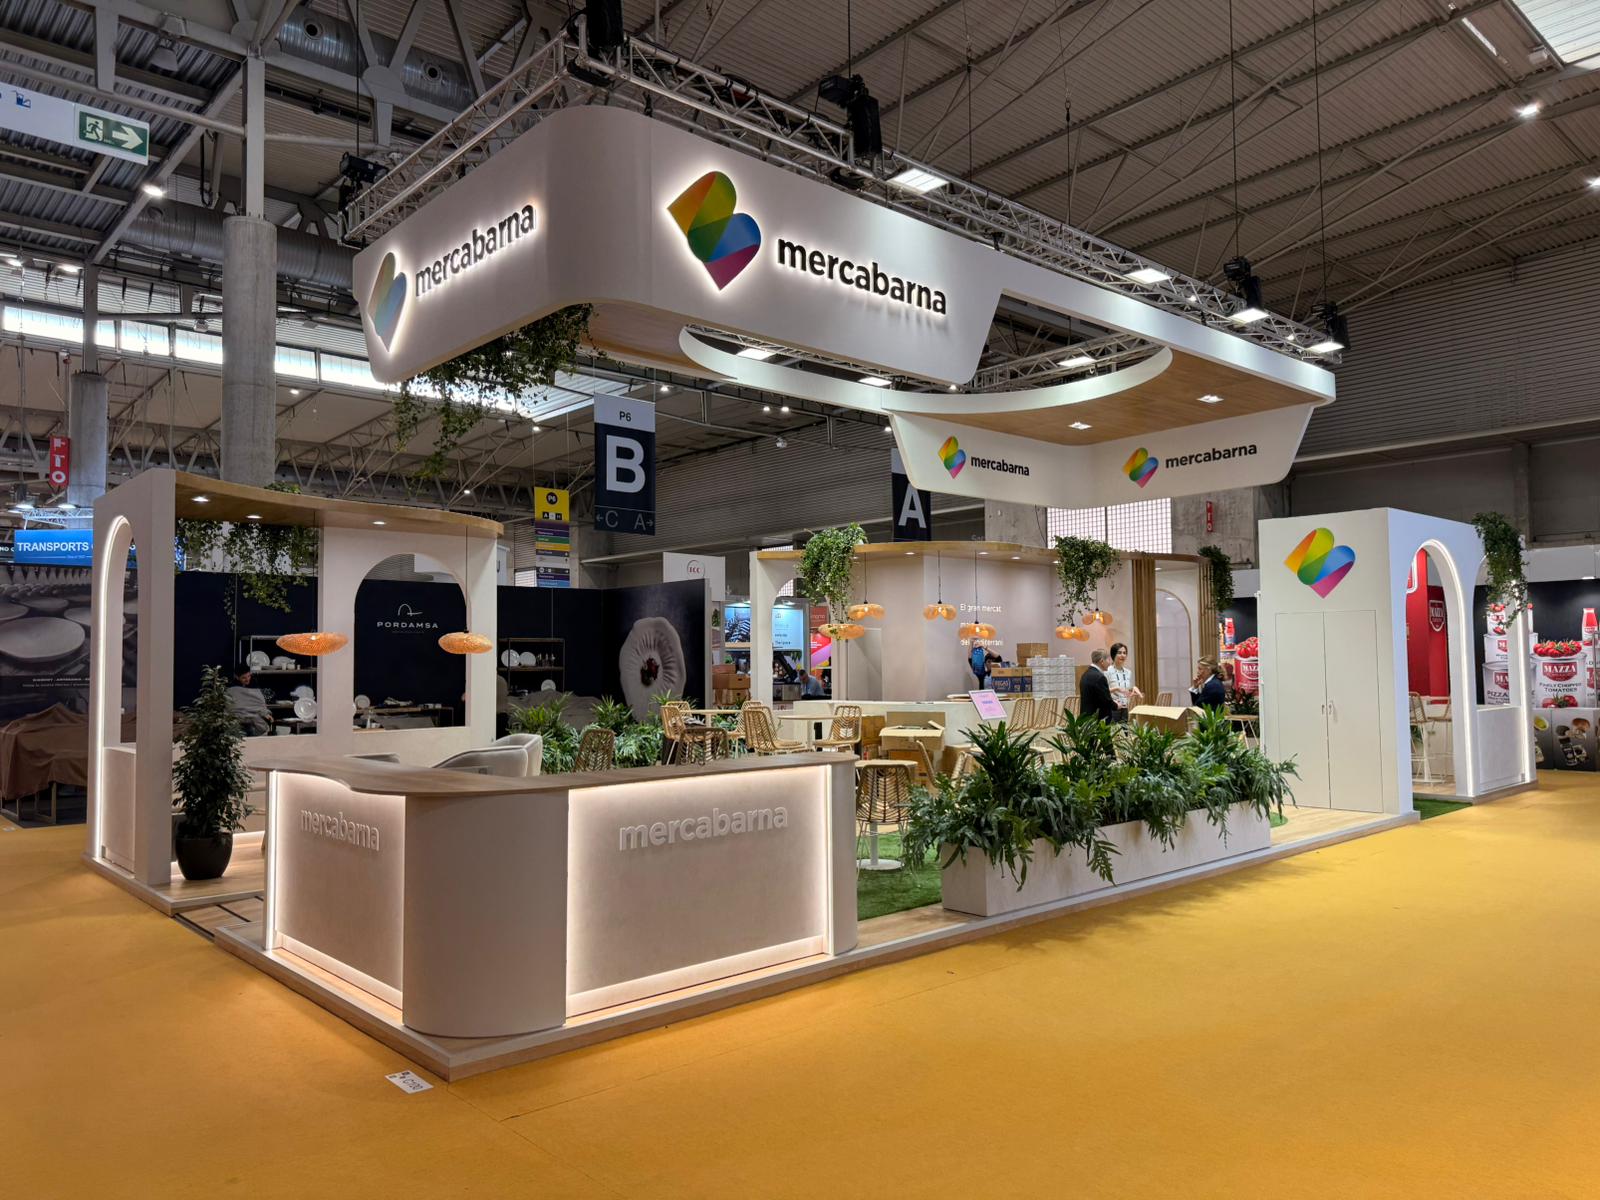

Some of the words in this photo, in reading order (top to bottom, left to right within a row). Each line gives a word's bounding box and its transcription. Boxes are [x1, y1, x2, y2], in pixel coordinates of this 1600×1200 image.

[416, 204, 535, 297] mercabarna
[777, 238, 947, 315] mercabarna
[619, 410, 632, 422] P6
[606, 434, 646, 493] B
[970, 456, 1030, 476] mercabarna
[1165, 444, 1258, 469] mercabarna
[898, 483, 927, 528] A
[605, 510, 619, 528] C
[634, 513, 647, 531] A
[17, 542, 89, 552] TRANSPORTS
[376, 621, 439, 629] PORDAMSA
[1543, 665, 1576, 673] MAZZA
[300, 810, 380, 851] mercabarna
[619, 806, 789, 851] mercabarna
